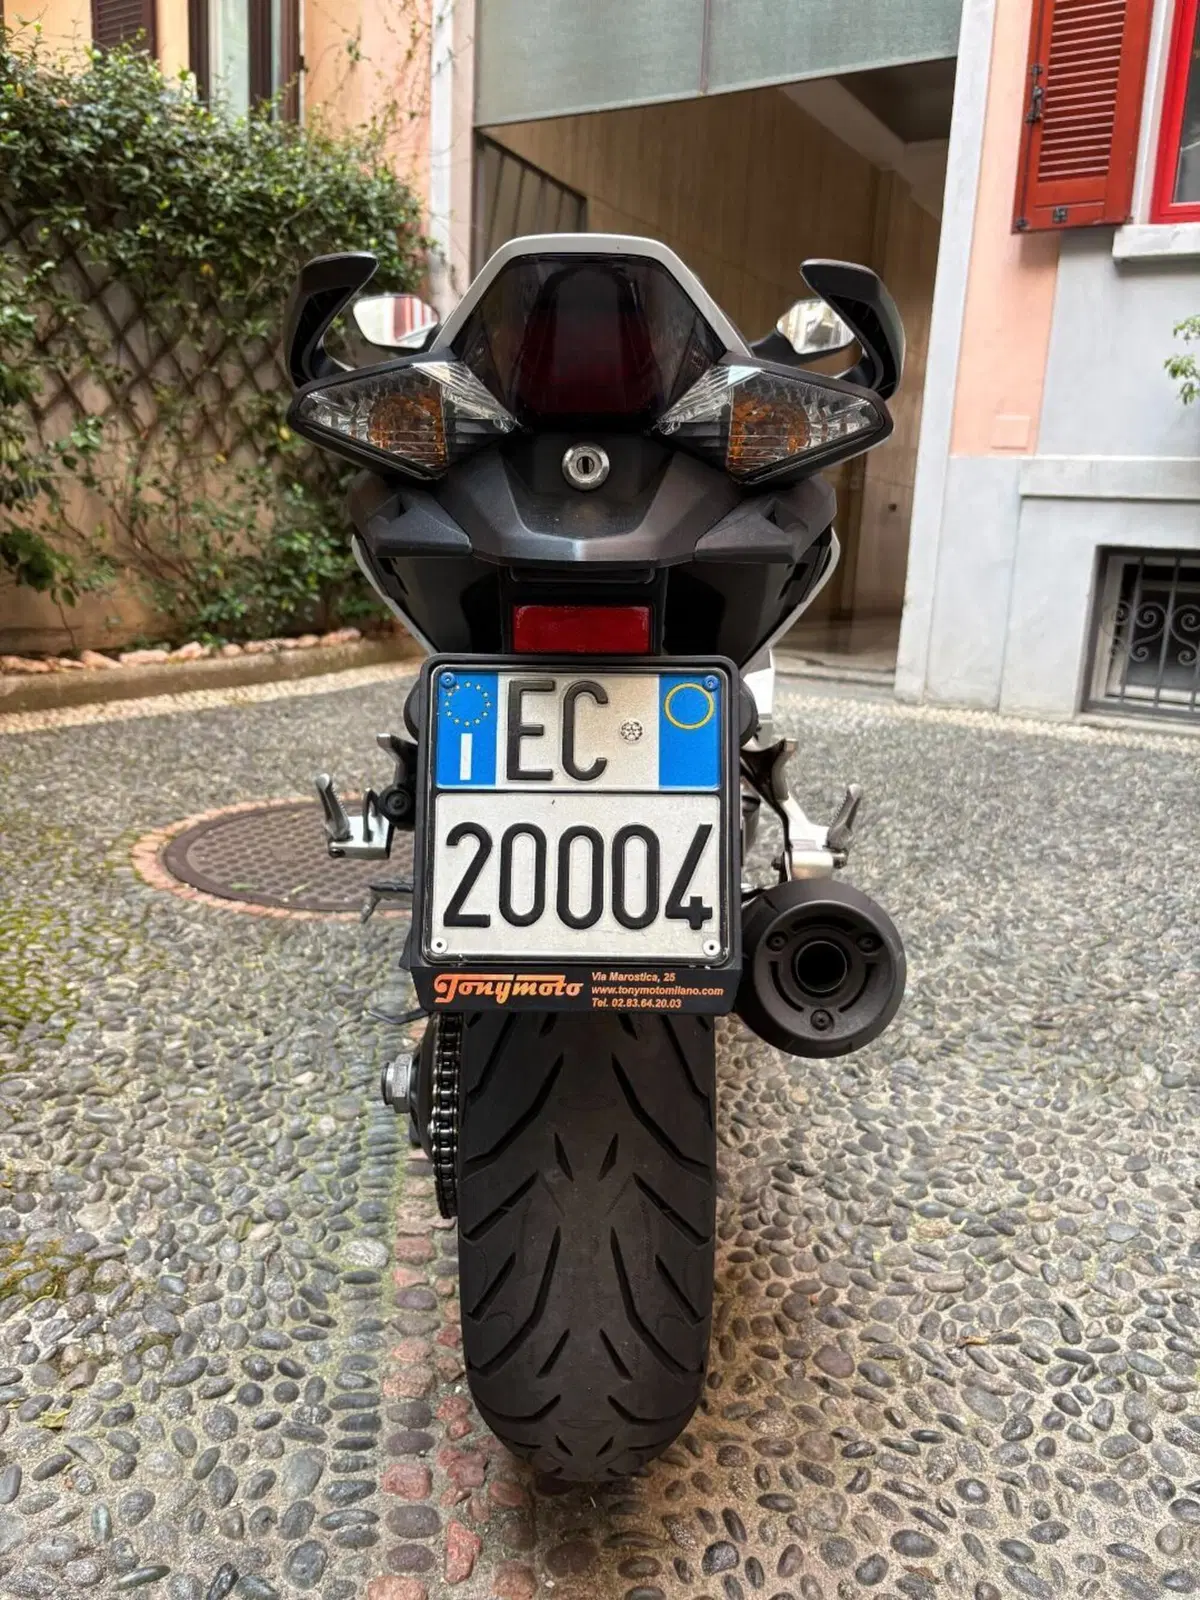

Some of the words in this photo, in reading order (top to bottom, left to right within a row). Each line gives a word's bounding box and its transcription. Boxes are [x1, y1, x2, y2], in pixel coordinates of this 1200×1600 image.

[506, 679, 609, 782] EC
[443, 821, 714, 931] 20004
[434, 973, 584, 1004] Tonymoto
[591, 971, 607, 982] Via
[609, 971, 661, 984] Marostica,
[663, 972, 676, 982] 25
[591, 985, 724, 997] www.tonymotomilano.com
[591, 997, 609, 1009] Tel.
[611, 998, 682, 1009] 02.83.64.20.03
